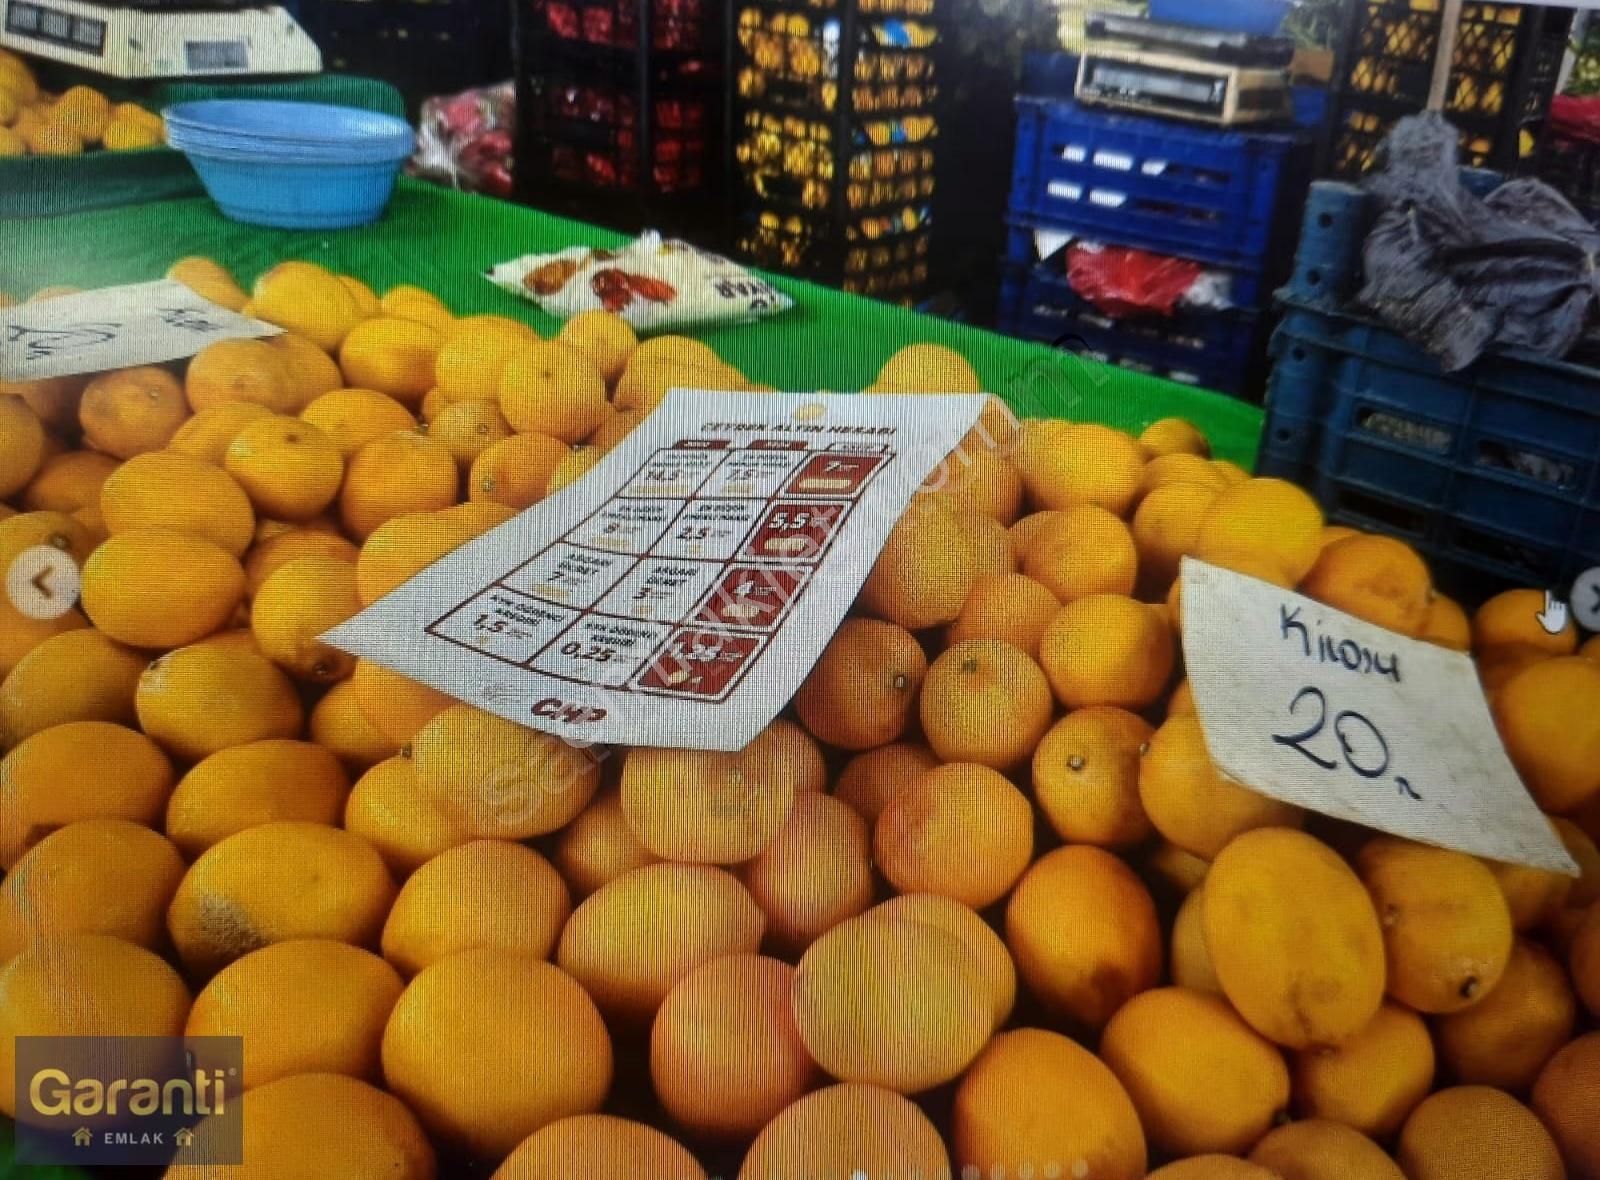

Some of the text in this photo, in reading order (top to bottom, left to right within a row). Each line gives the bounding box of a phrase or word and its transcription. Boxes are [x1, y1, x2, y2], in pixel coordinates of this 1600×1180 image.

[768, 512, 810, 530] 5,5
[677, 526, 711, 541] 2,5
[473, 614, 509, 633] 1,5
[560, 640, 616, 663] 0,25
[1271, 686, 1390, 779] 20
